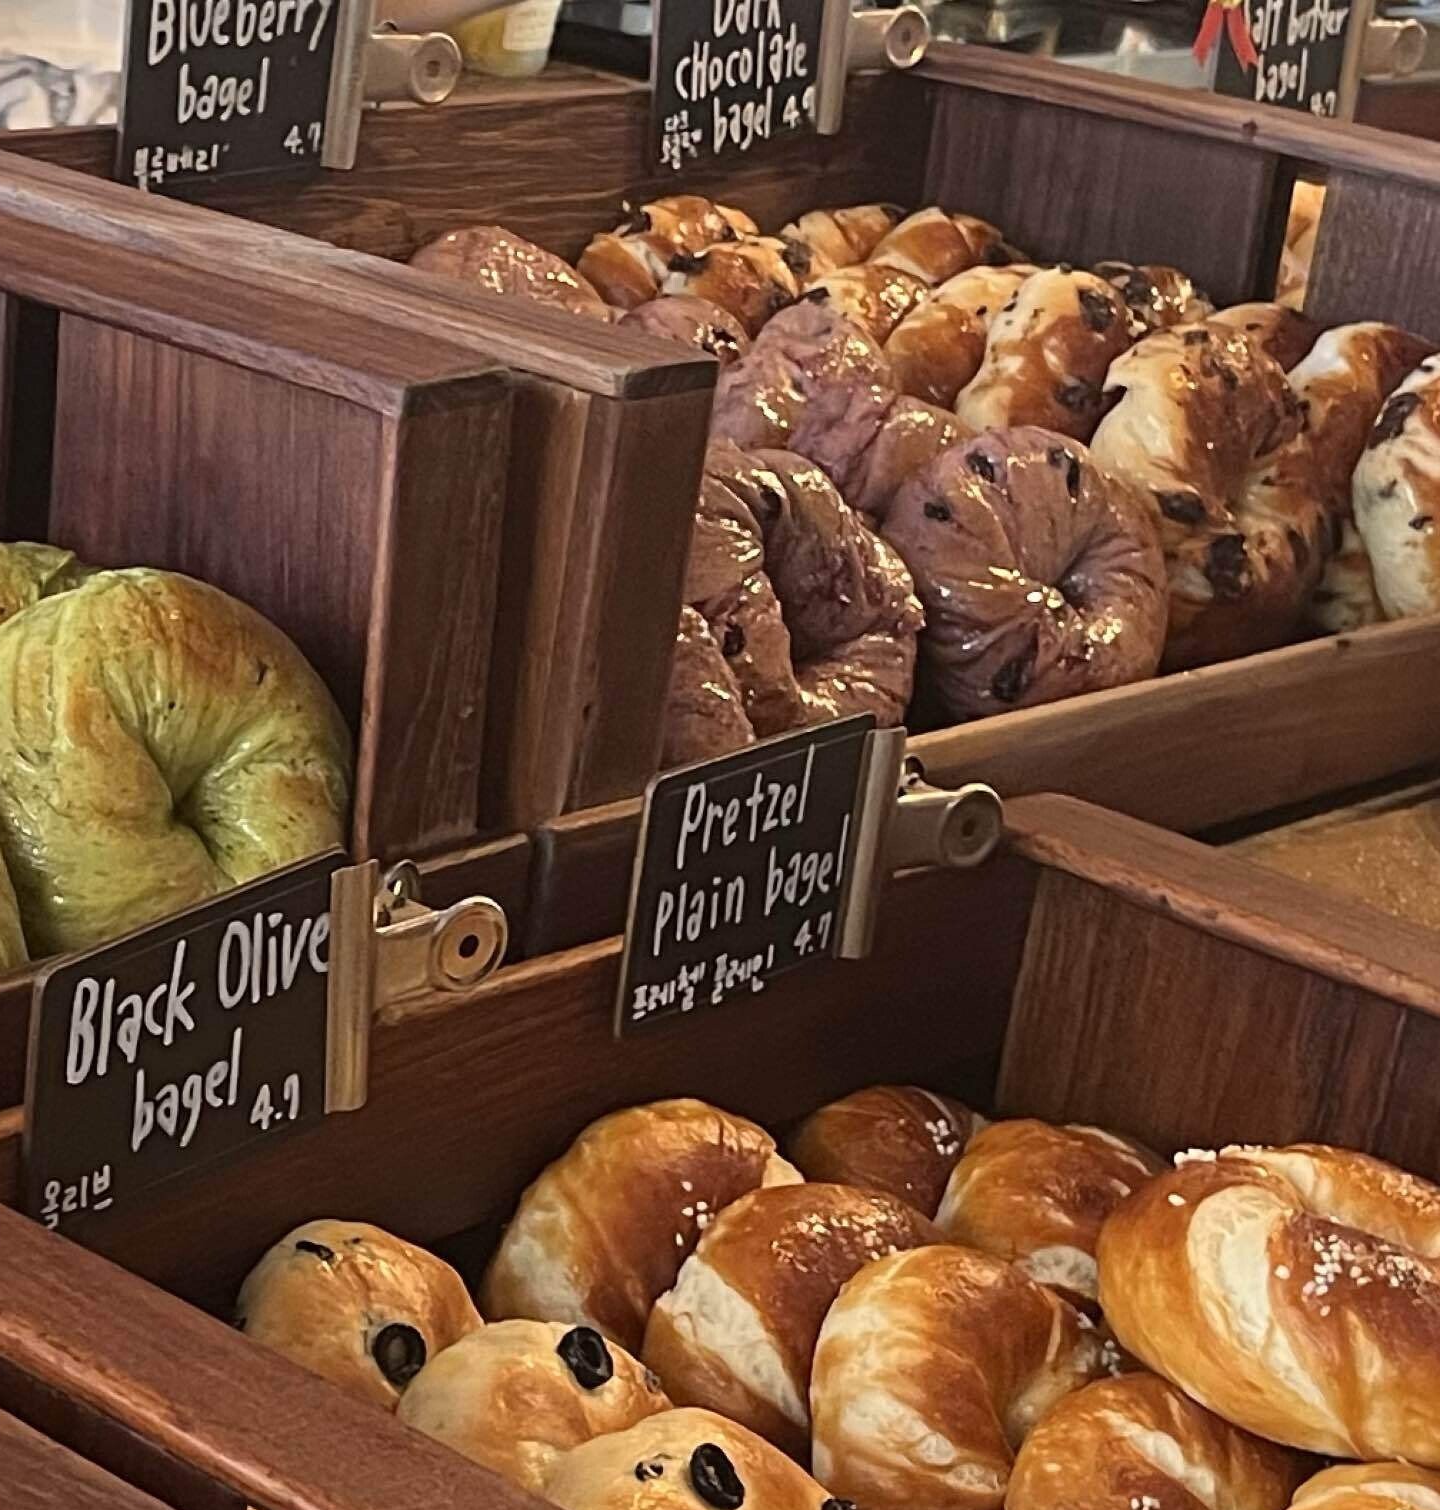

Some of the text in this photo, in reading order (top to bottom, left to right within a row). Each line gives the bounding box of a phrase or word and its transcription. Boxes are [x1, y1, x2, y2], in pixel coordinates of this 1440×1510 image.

[178, 56, 271, 124] bagel
[713, 85, 773, 155] bagel
[283, 121, 322, 155] 4.7
[676, 743, 815, 870] Pretzel
[764, 813, 850, 916] bagel
[794, 911, 833, 956] 4.7
[66, 911, 330, 1085] Black Olive
[131, 1027, 300, 1152] bagel 4.7
[39, 1164, 114, 1230] 올리브
